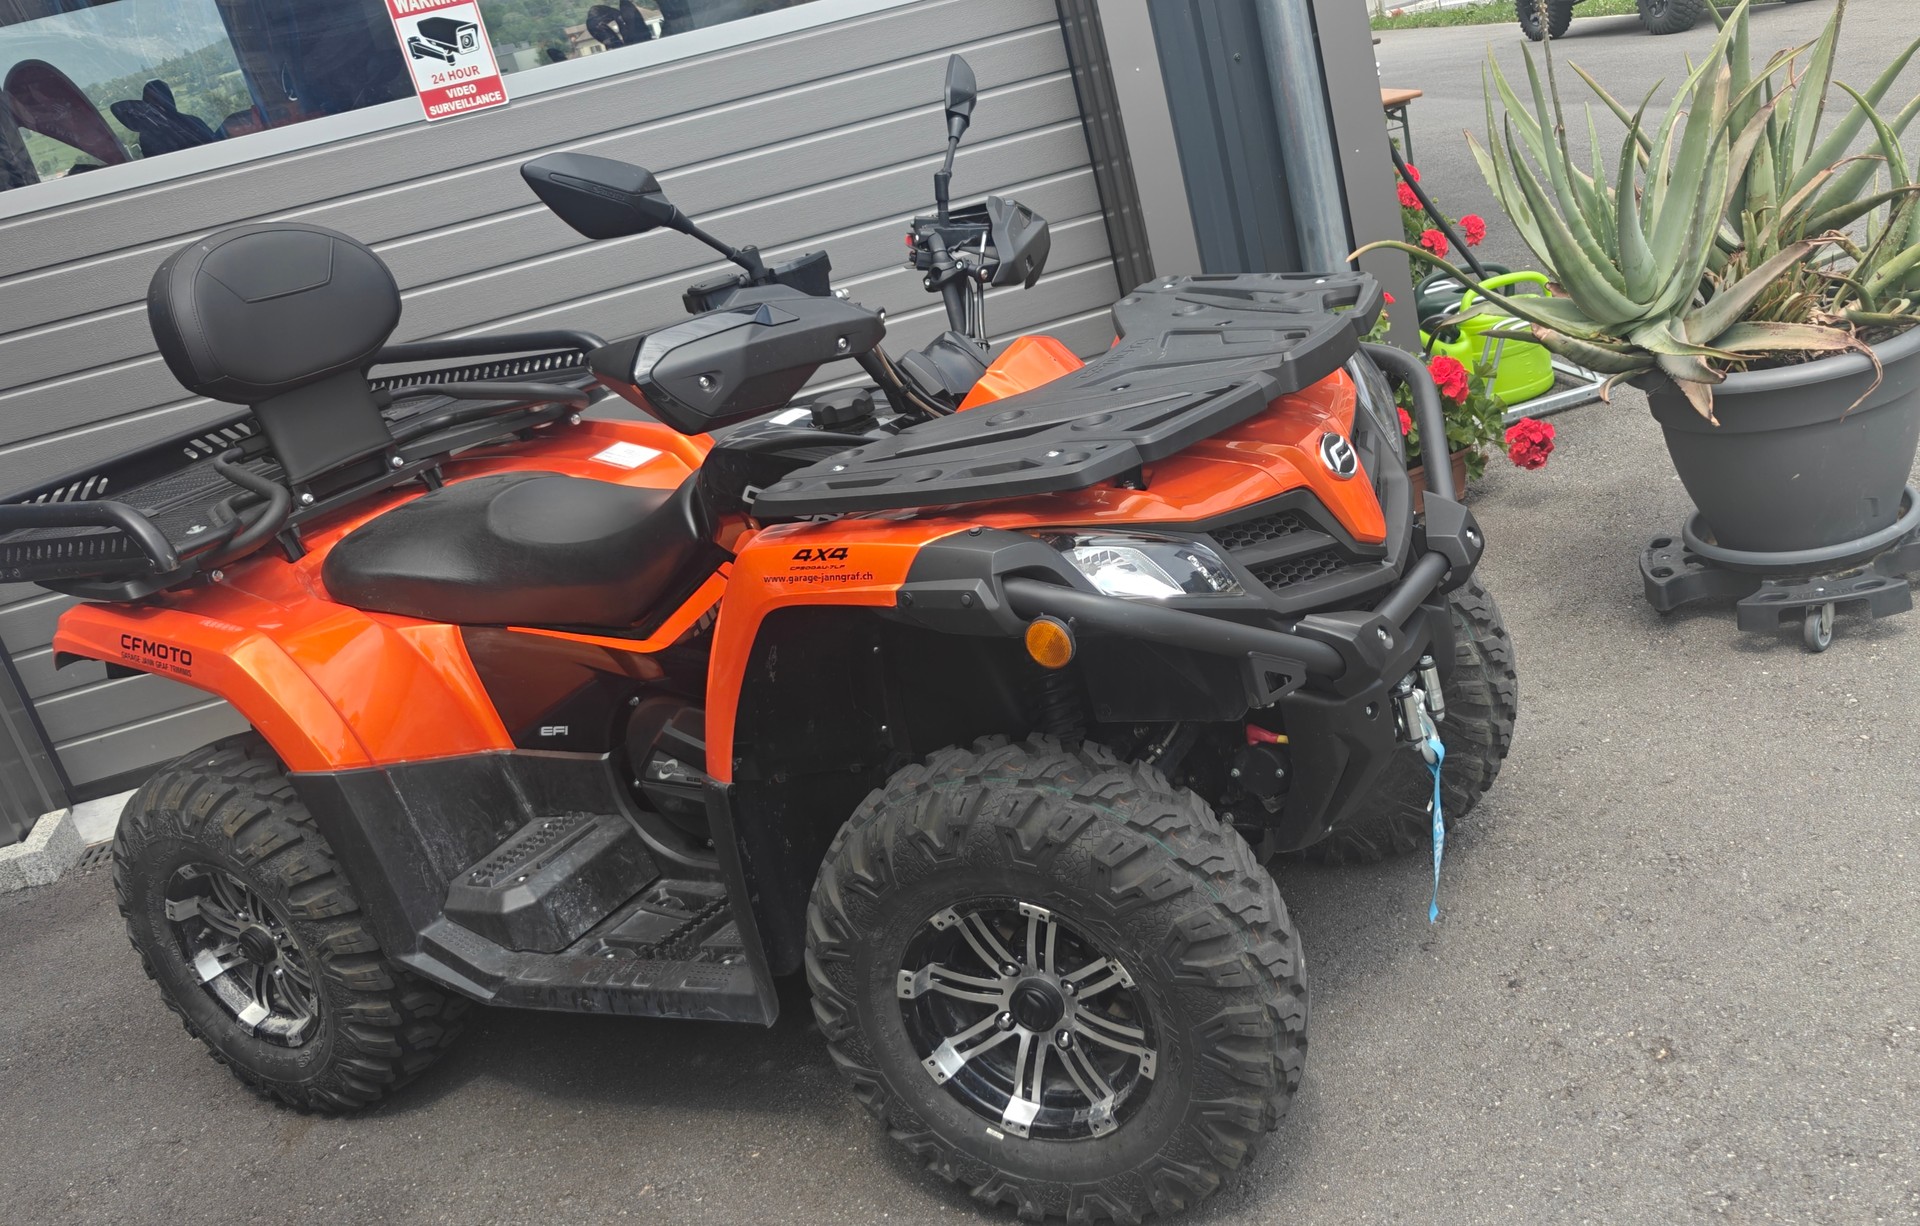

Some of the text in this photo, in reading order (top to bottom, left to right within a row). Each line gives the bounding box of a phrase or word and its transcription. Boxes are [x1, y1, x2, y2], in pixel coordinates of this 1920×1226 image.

[431, 65, 480, 84] 24 HOUR
[445, 84, 477, 98] VIDEO
[429, 91, 502, 115] SURVEILLANCE
[763, 572, 873, 584] www.garage-janngraf.ch
[121, 633, 192, 666] CFMOTO
[540, 725, 568, 736] EFI
